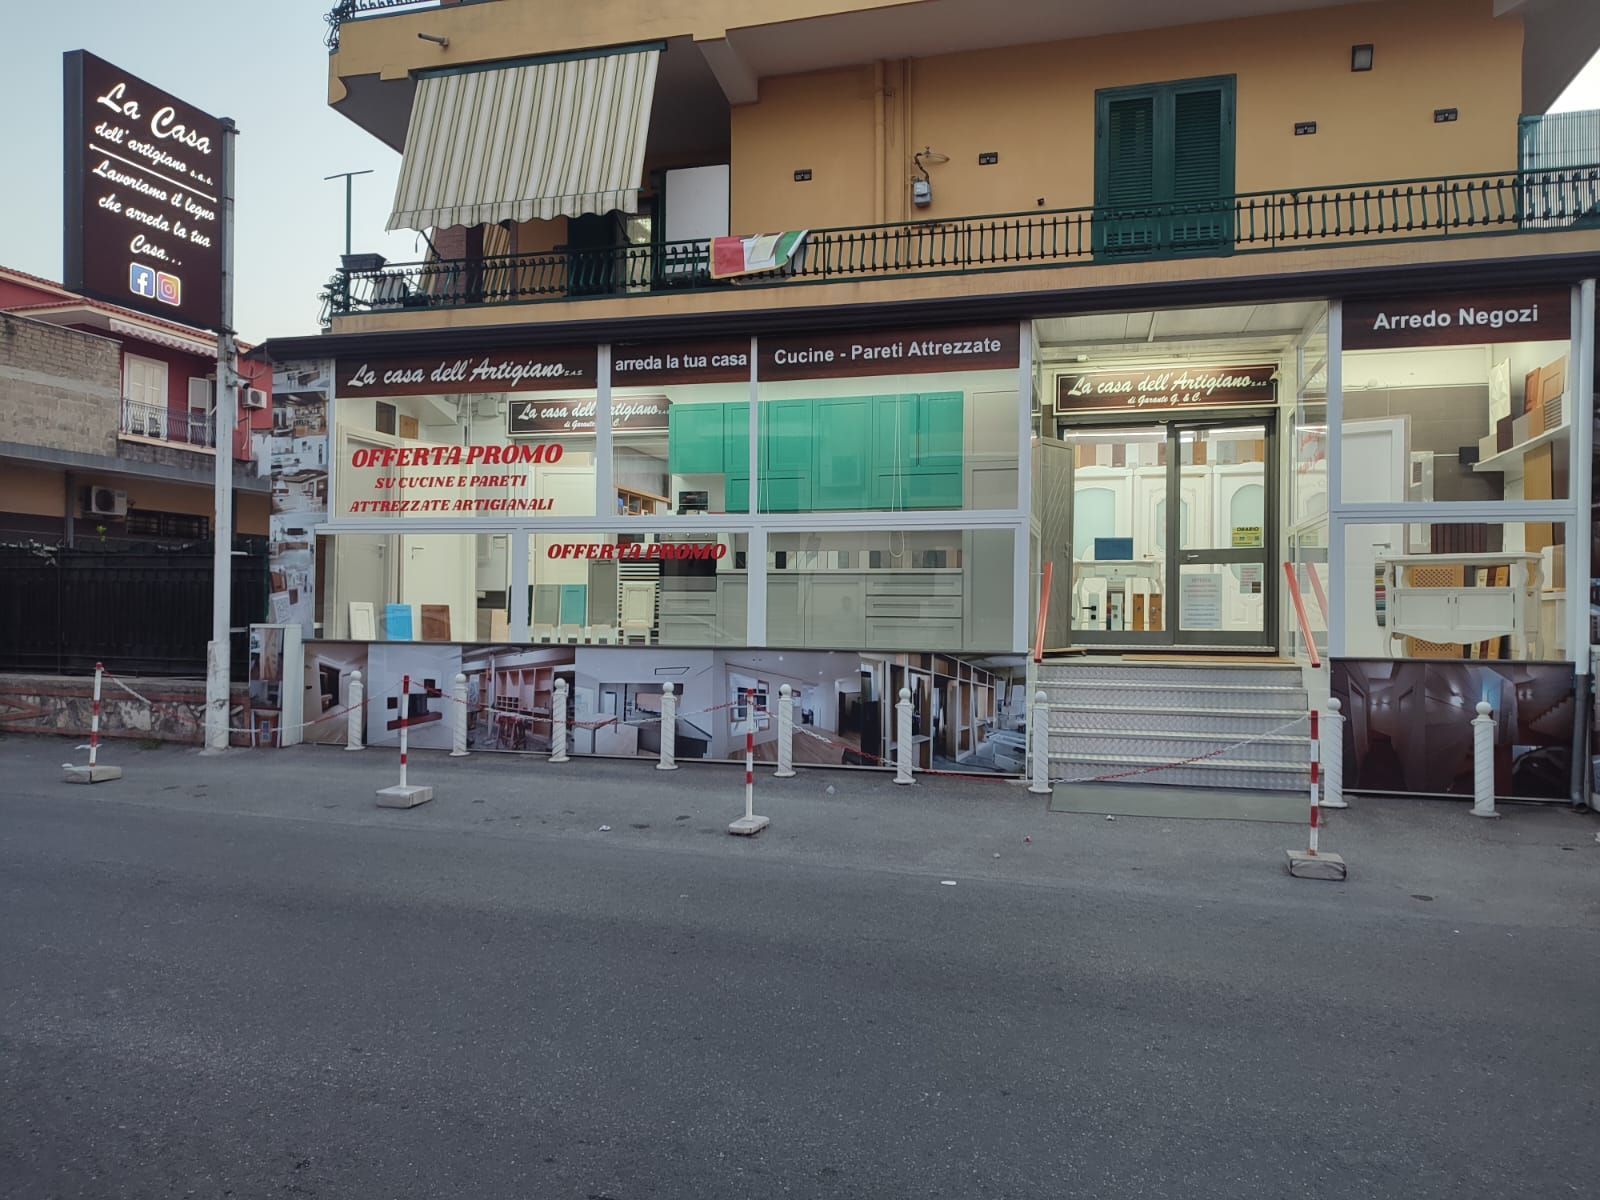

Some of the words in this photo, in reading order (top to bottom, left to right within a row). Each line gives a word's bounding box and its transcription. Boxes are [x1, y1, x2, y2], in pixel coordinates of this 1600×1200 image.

[97, 83, 141, 119] La
[151, 107, 211, 154] Casa
[127, 139, 187, 173] artigiano
[92, 160, 167, 201] Lavoriamo
[171, 193, 182, 207] il
[185, 197, 215, 221] legno
[98, 193, 122, 213] che
[126, 207, 170, 232] arreda
[173, 221, 187, 239] la
[190, 230, 211, 248] tua
[1373, 308, 1451, 330] Arredo
[1459, 304, 1538, 330] Negozi
[615, 355, 662, 371] arreda
[666, 354, 680, 369] la
[683, 354, 708, 368] tua
[711, 353, 747, 367] casa
[774, 349, 834, 365] Cucine
[851, 343, 902, 361] Pareti
[907, 337, 1001, 357] Attrezzate
[347, 364, 377, 387] La
[383, 369, 425, 385] casa
[1067, 376, 1093, 397] La
[1097, 381, 1133, 395] casa
[1127, 396, 1136, 404] di
[518, 403, 538, 421] La
[541, 407, 569, 419] casa
[352, 446, 463, 468] OFFERTA
[466, 443, 563, 465] PROMO
[375, 477, 397, 489] SU
[399, 476, 455, 488] CUCINE
[457, 476, 468, 488] E
[469, 475, 528, 487] PARETI
[349, 499, 451, 512] ATTREZZATE
[452, 498, 554, 511] ARTIGIANALI
[547, 543, 641, 560] OFFERTA
[644, 543, 727, 560] PROMO
